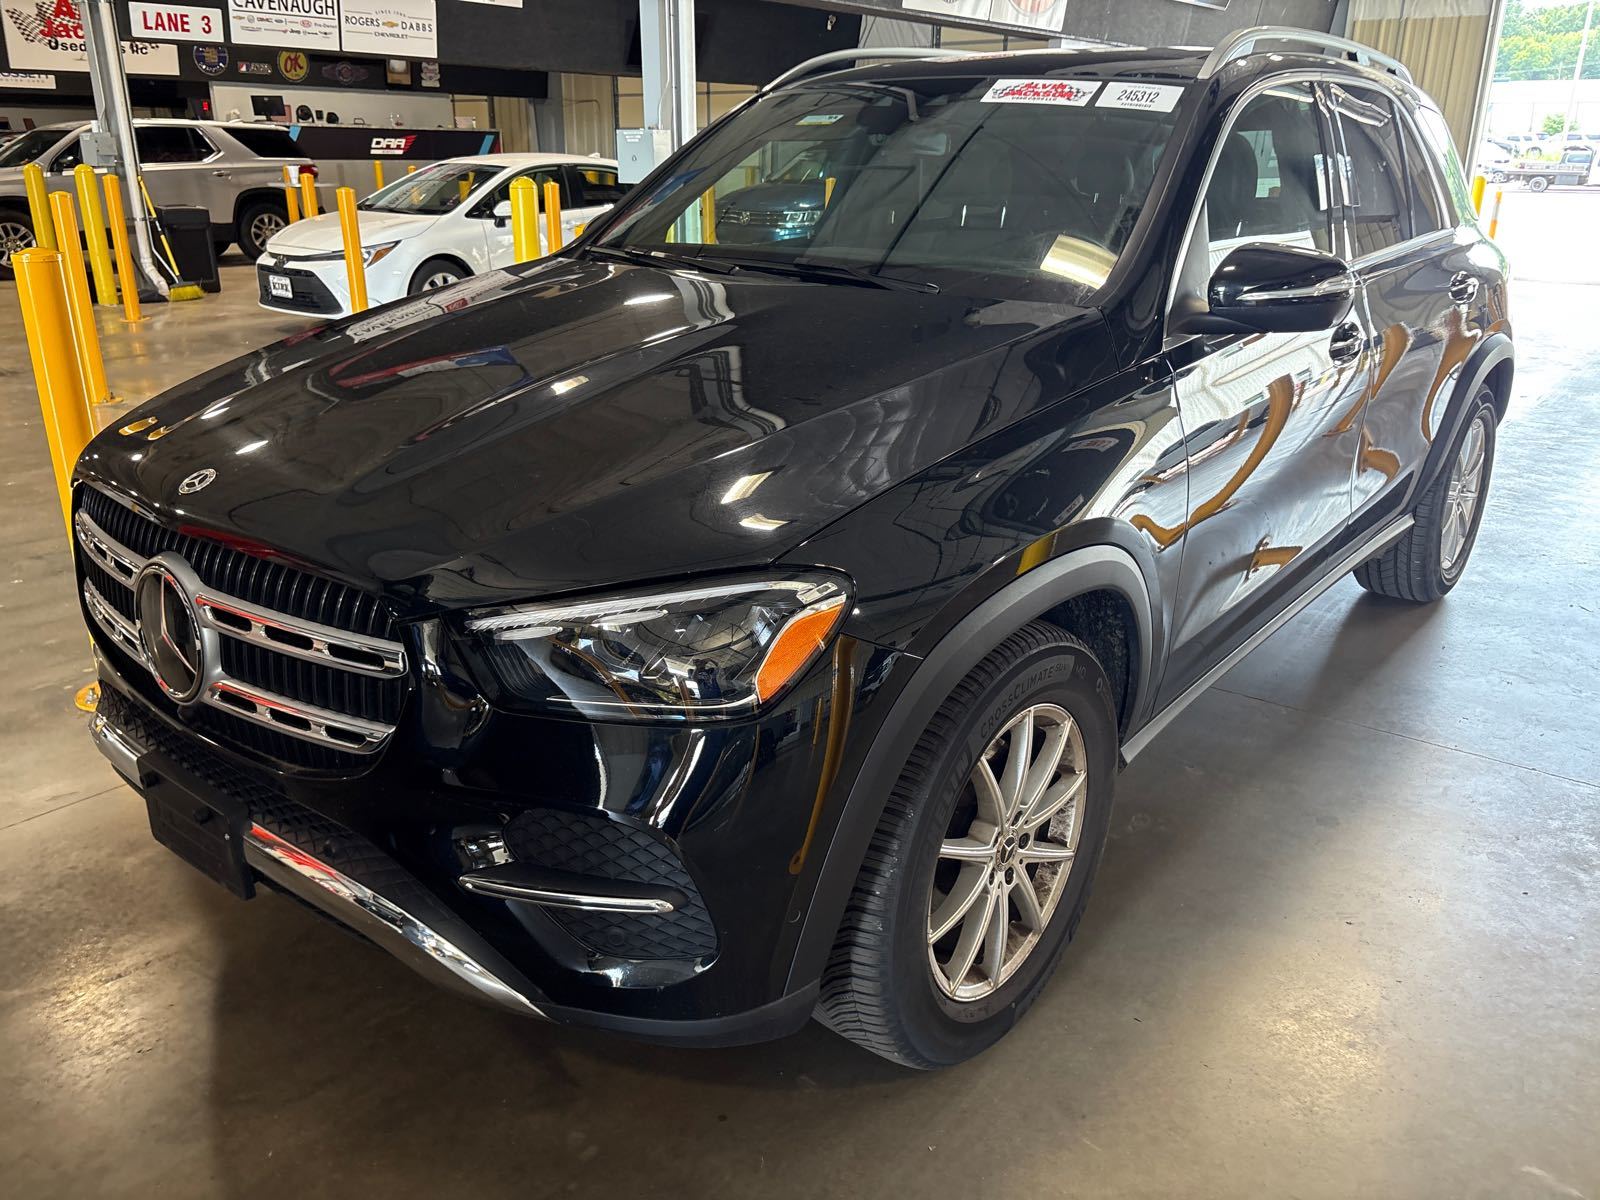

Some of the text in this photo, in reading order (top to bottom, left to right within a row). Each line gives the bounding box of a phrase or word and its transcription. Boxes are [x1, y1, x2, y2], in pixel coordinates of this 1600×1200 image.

[232, 0, 336, 16] CAVENAUGH
[142, 11, 212, 34] LANE 3
[345, 15, 433, 32] ROGERS DABBS
[283, 52, 304, 74] OK
[1117, 89, 1160, 103] 245312
[371, 137, 407, 149] DAA
